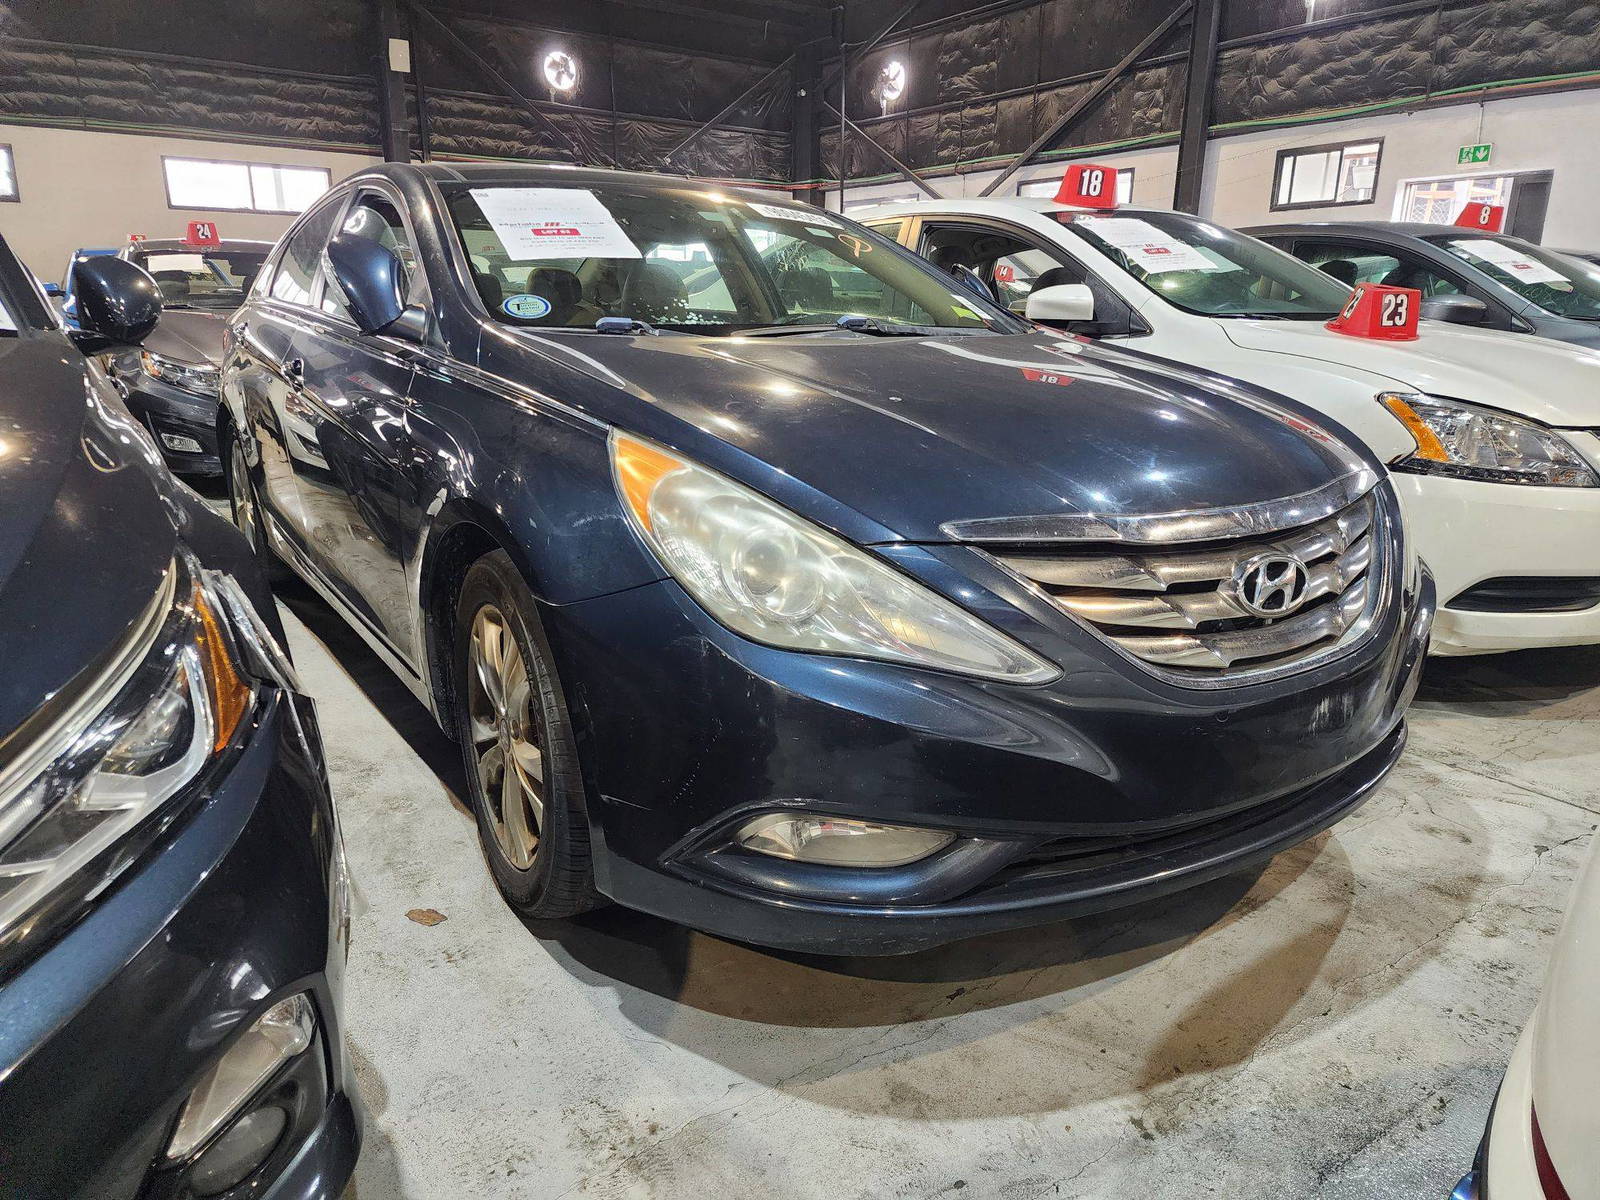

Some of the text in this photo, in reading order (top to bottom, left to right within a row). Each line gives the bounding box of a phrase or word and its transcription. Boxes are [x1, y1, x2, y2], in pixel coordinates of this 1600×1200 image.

[1081, 169, 1103, 196] 18
[1480, 206, 1491, 225] 8
[196, 224, 211, 239] 24
[1381, 294, 1409, 326] 23
